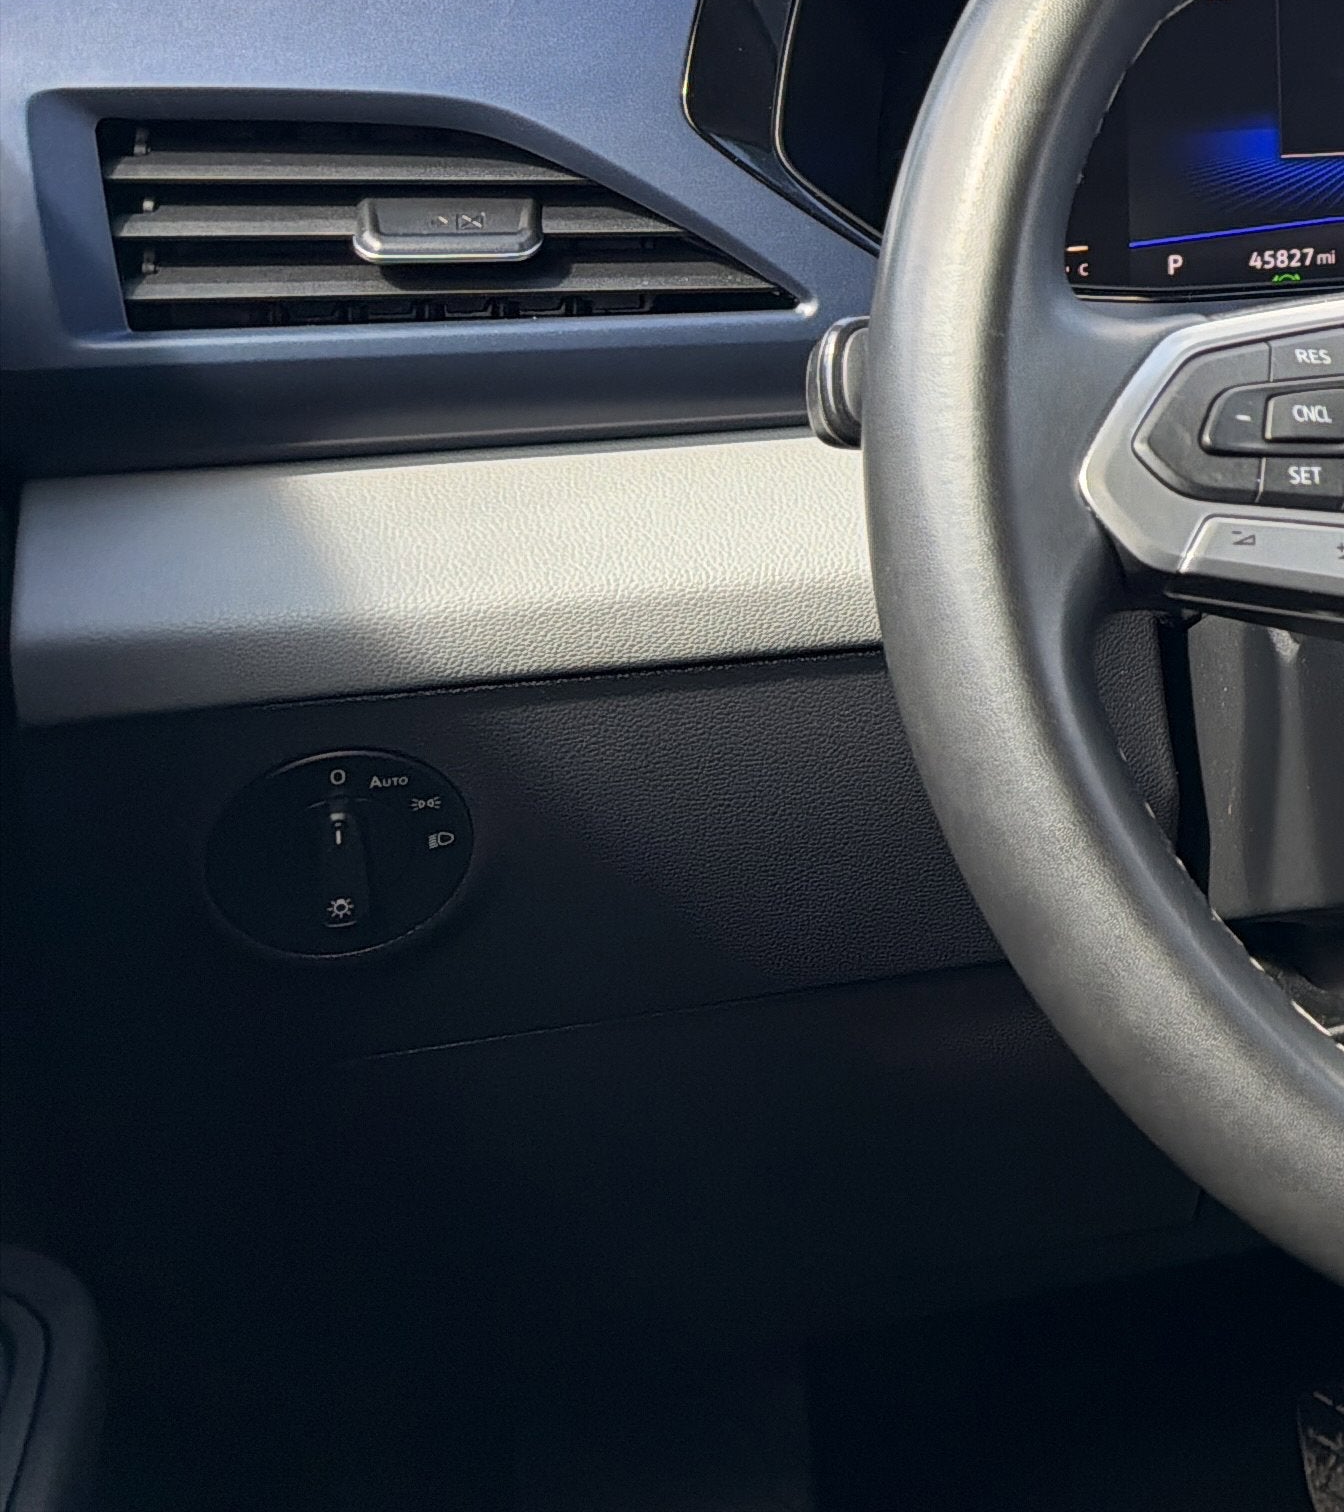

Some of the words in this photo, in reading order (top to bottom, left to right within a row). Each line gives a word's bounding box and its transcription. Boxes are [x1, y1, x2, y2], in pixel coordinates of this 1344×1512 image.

[1167, 254, 1184, 276] P
[1249, 248, 1314, 270] 45827
[1316, 249, 1336, 265] mi
[1295, 348, 1332, 365] RES
[1292, 403, 1332, 424] CNCL
[1288, 466, 1323, 485] SET
